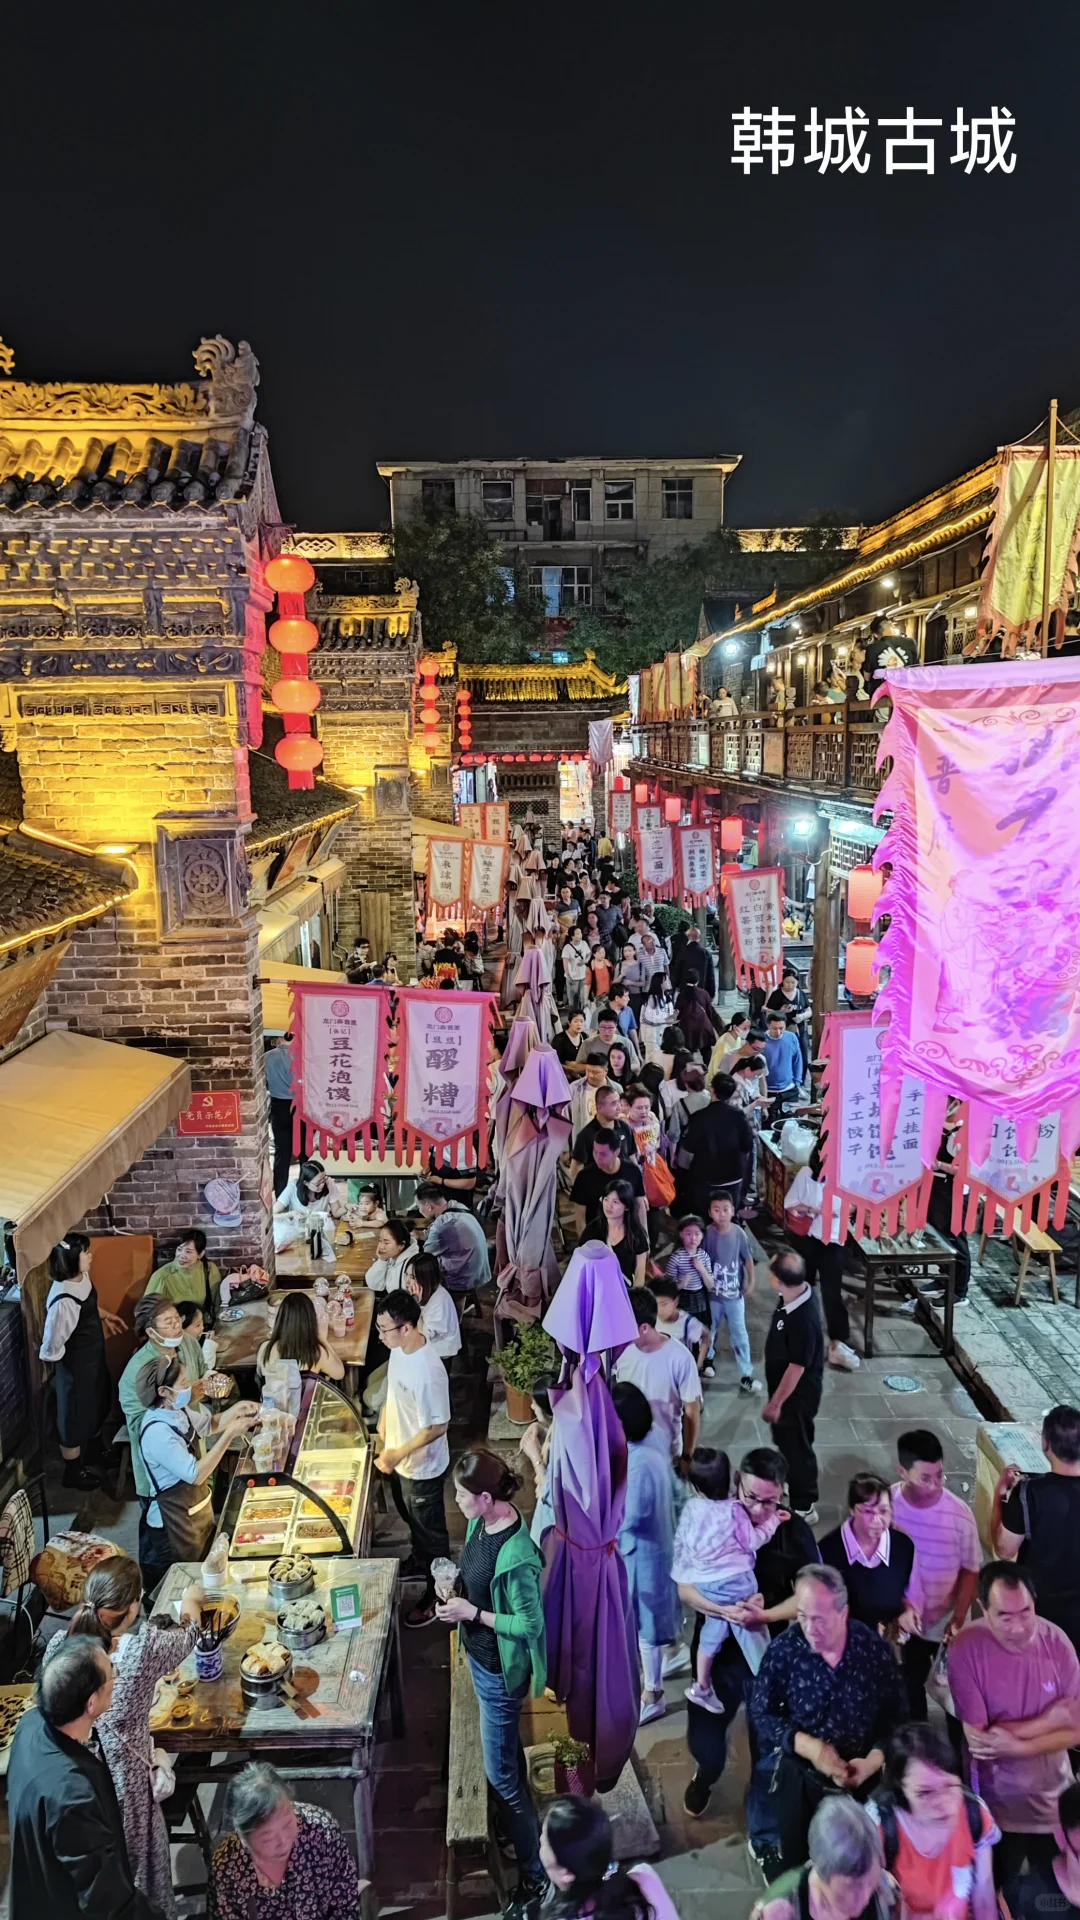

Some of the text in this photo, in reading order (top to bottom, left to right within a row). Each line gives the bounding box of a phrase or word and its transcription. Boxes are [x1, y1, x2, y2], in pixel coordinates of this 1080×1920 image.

[325, 1037, 353, 1102] 豆花泡馍
[423, 1048, 460, 1108] 醪糟
[185, 1110, 232, 1120] 党员示范户
[847, 1092, 865, 1156] 手工饺子
[902, 1089, 923, 1150] 手工挂面
